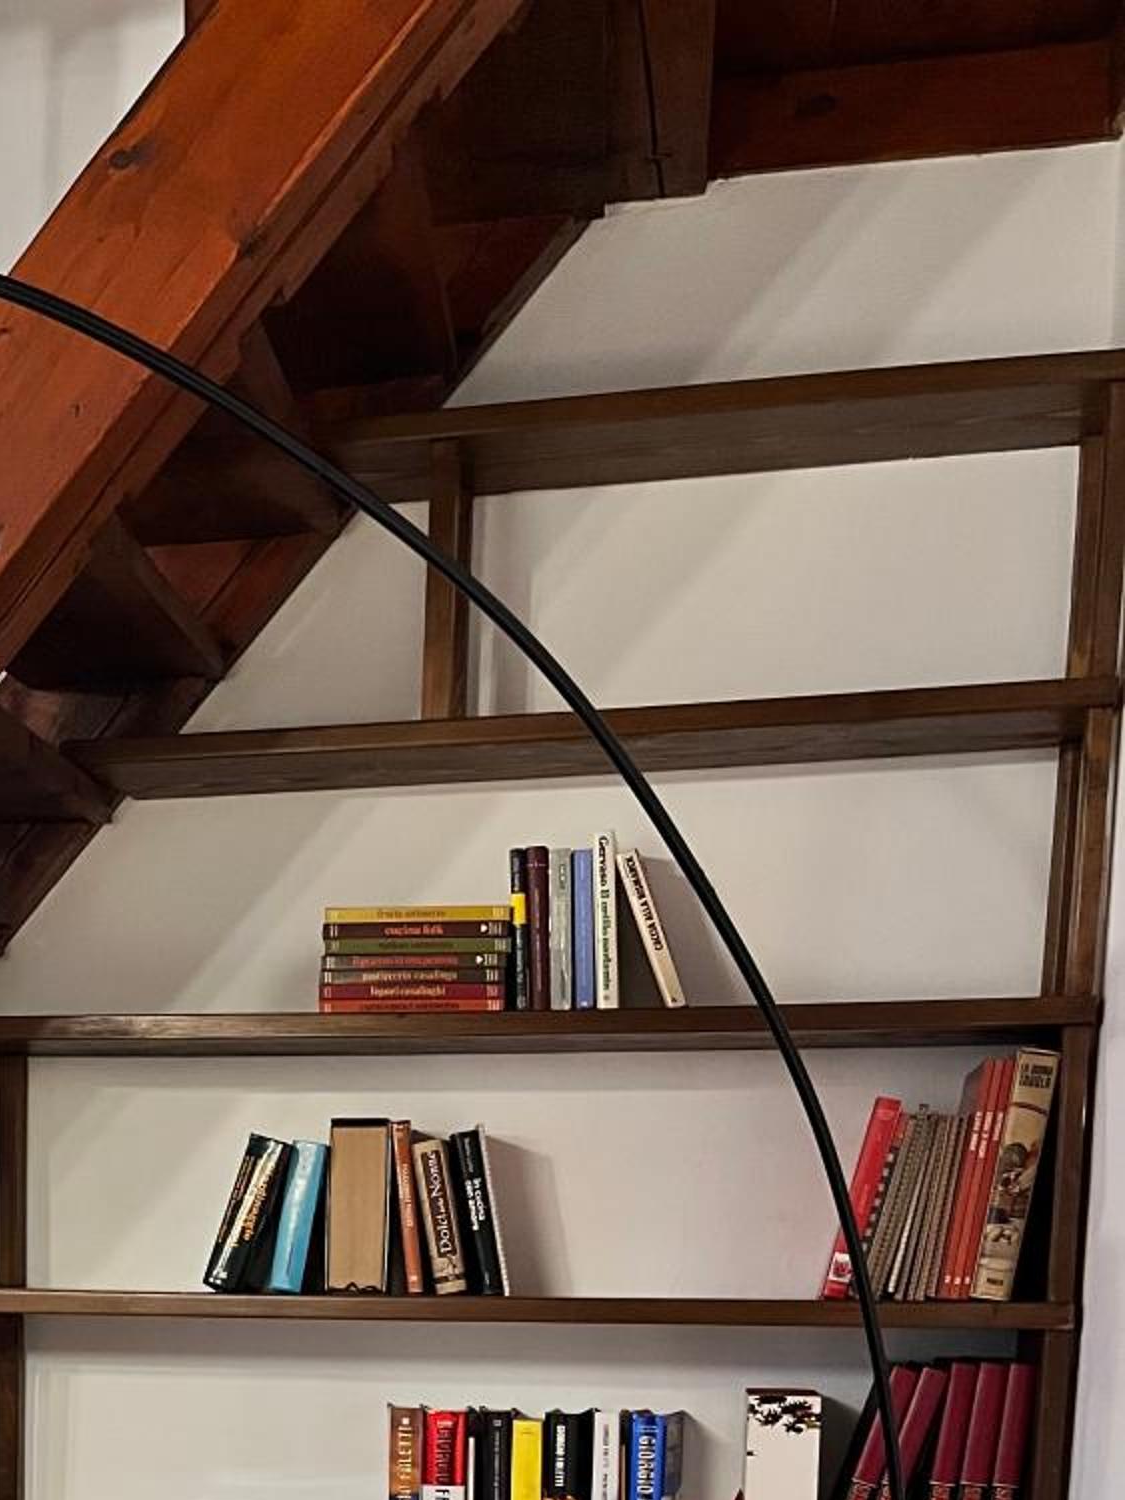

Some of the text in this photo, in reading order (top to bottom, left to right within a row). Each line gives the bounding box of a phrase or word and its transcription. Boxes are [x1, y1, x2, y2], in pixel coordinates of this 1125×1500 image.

[598, 836, 610, 887] Gervaso
[640, 901, 654, 921] ALLA
[437, 1217, 452, 1254] Dolci
[398, 1427, 412, 1481] FALETTI
[636, 1435, 655, 1493] GIORGIO
